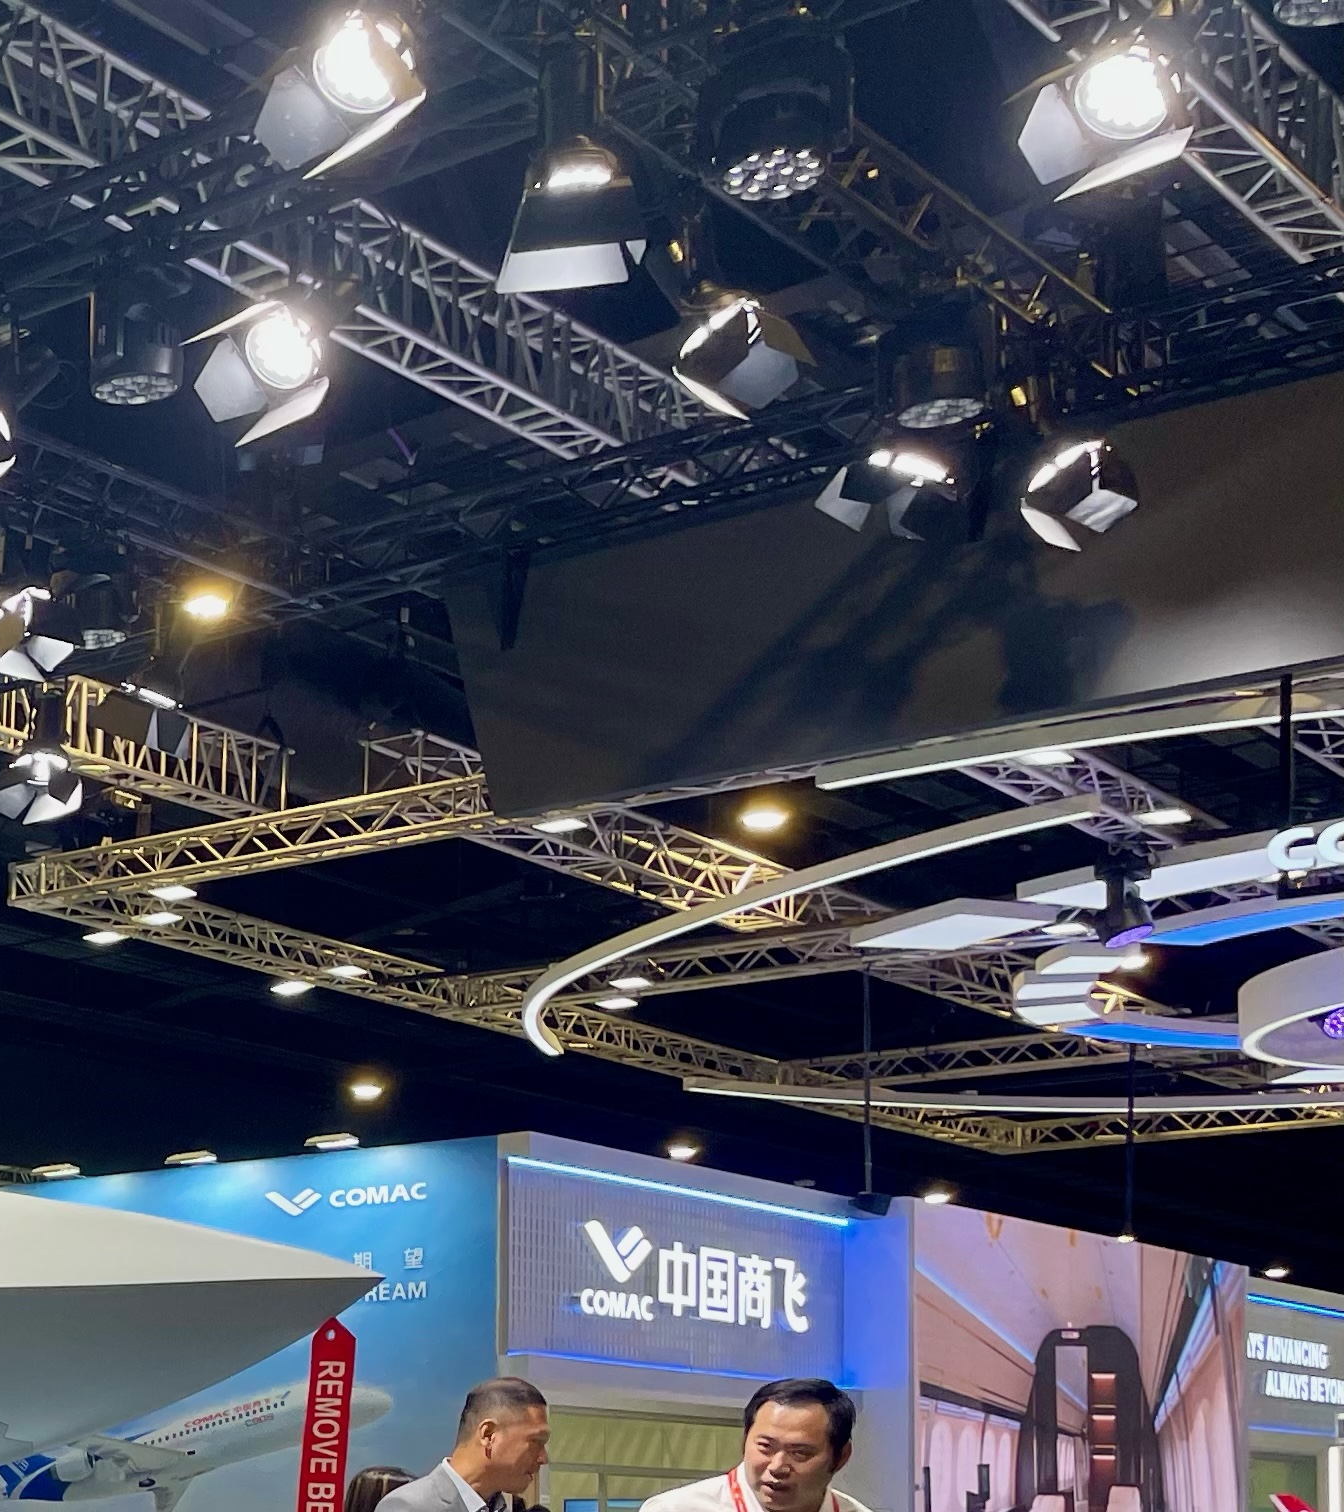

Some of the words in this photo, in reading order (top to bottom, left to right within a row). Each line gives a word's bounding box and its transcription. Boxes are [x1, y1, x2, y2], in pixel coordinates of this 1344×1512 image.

[329, 1182, 427, 1207] COMAC
[658, 1241, 810, 1333] 中国商飞
[580, 1288, 654, 1321] COMAC
[1265, 1335, 1330, 1370] ADVANCING
[1265, 1370, 1309, 1400] ALWAYS
[308, 1360, 346, 1475] REMOVE
